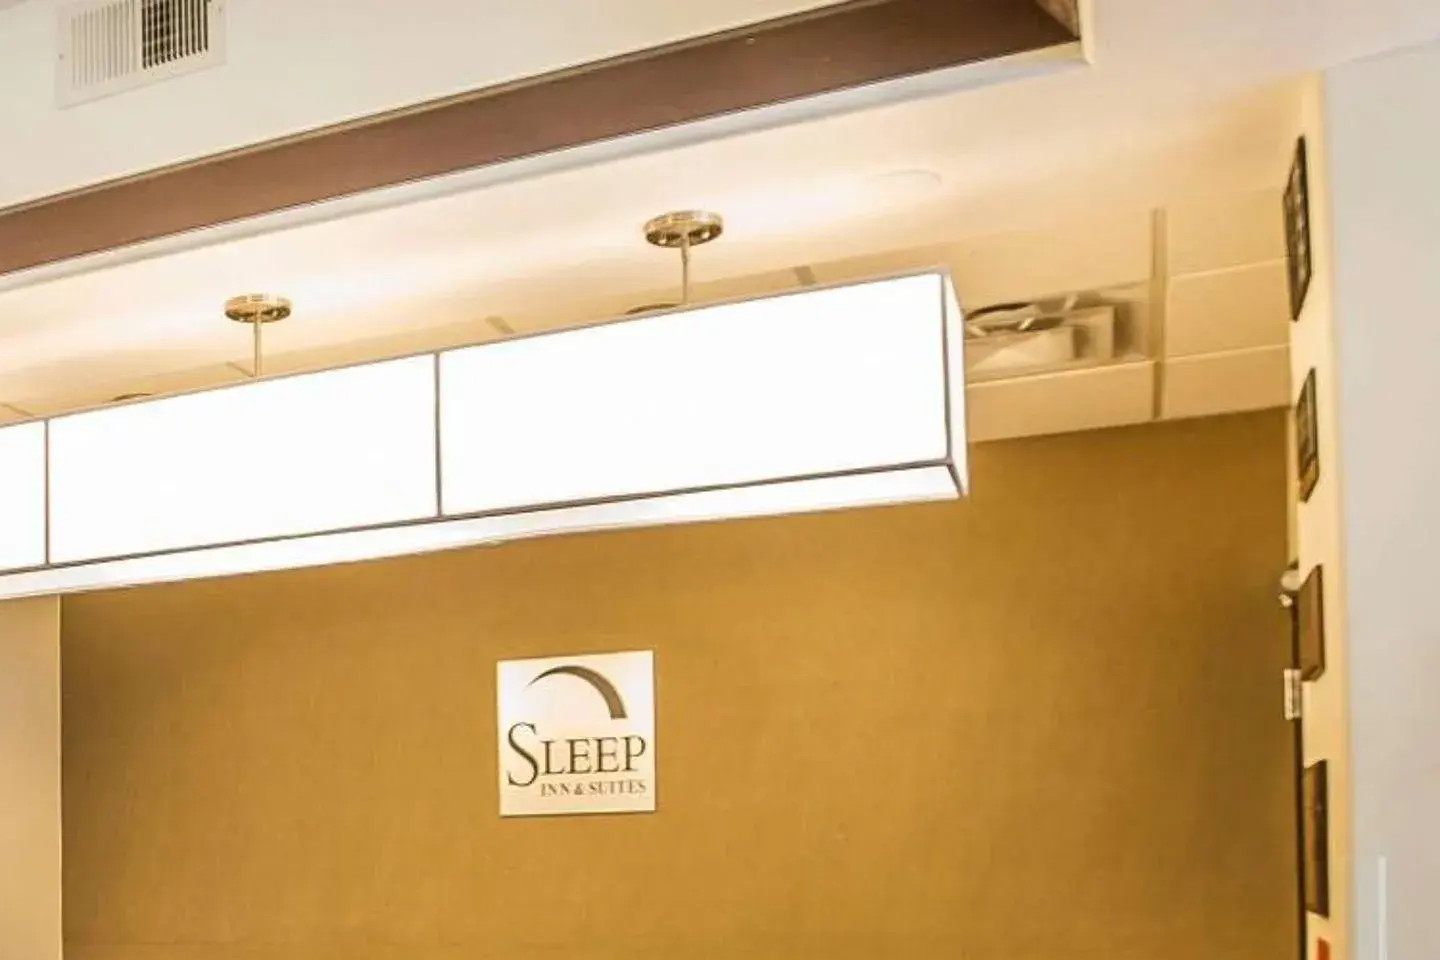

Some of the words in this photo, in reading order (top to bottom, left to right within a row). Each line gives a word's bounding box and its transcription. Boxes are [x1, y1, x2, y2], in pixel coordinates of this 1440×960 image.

[507, 721, 647, 788] SLEEP
[540, 782, 570, 797] INN
[574, 782, 585, 796] &
[589, 778, 647, 795] SUITES
